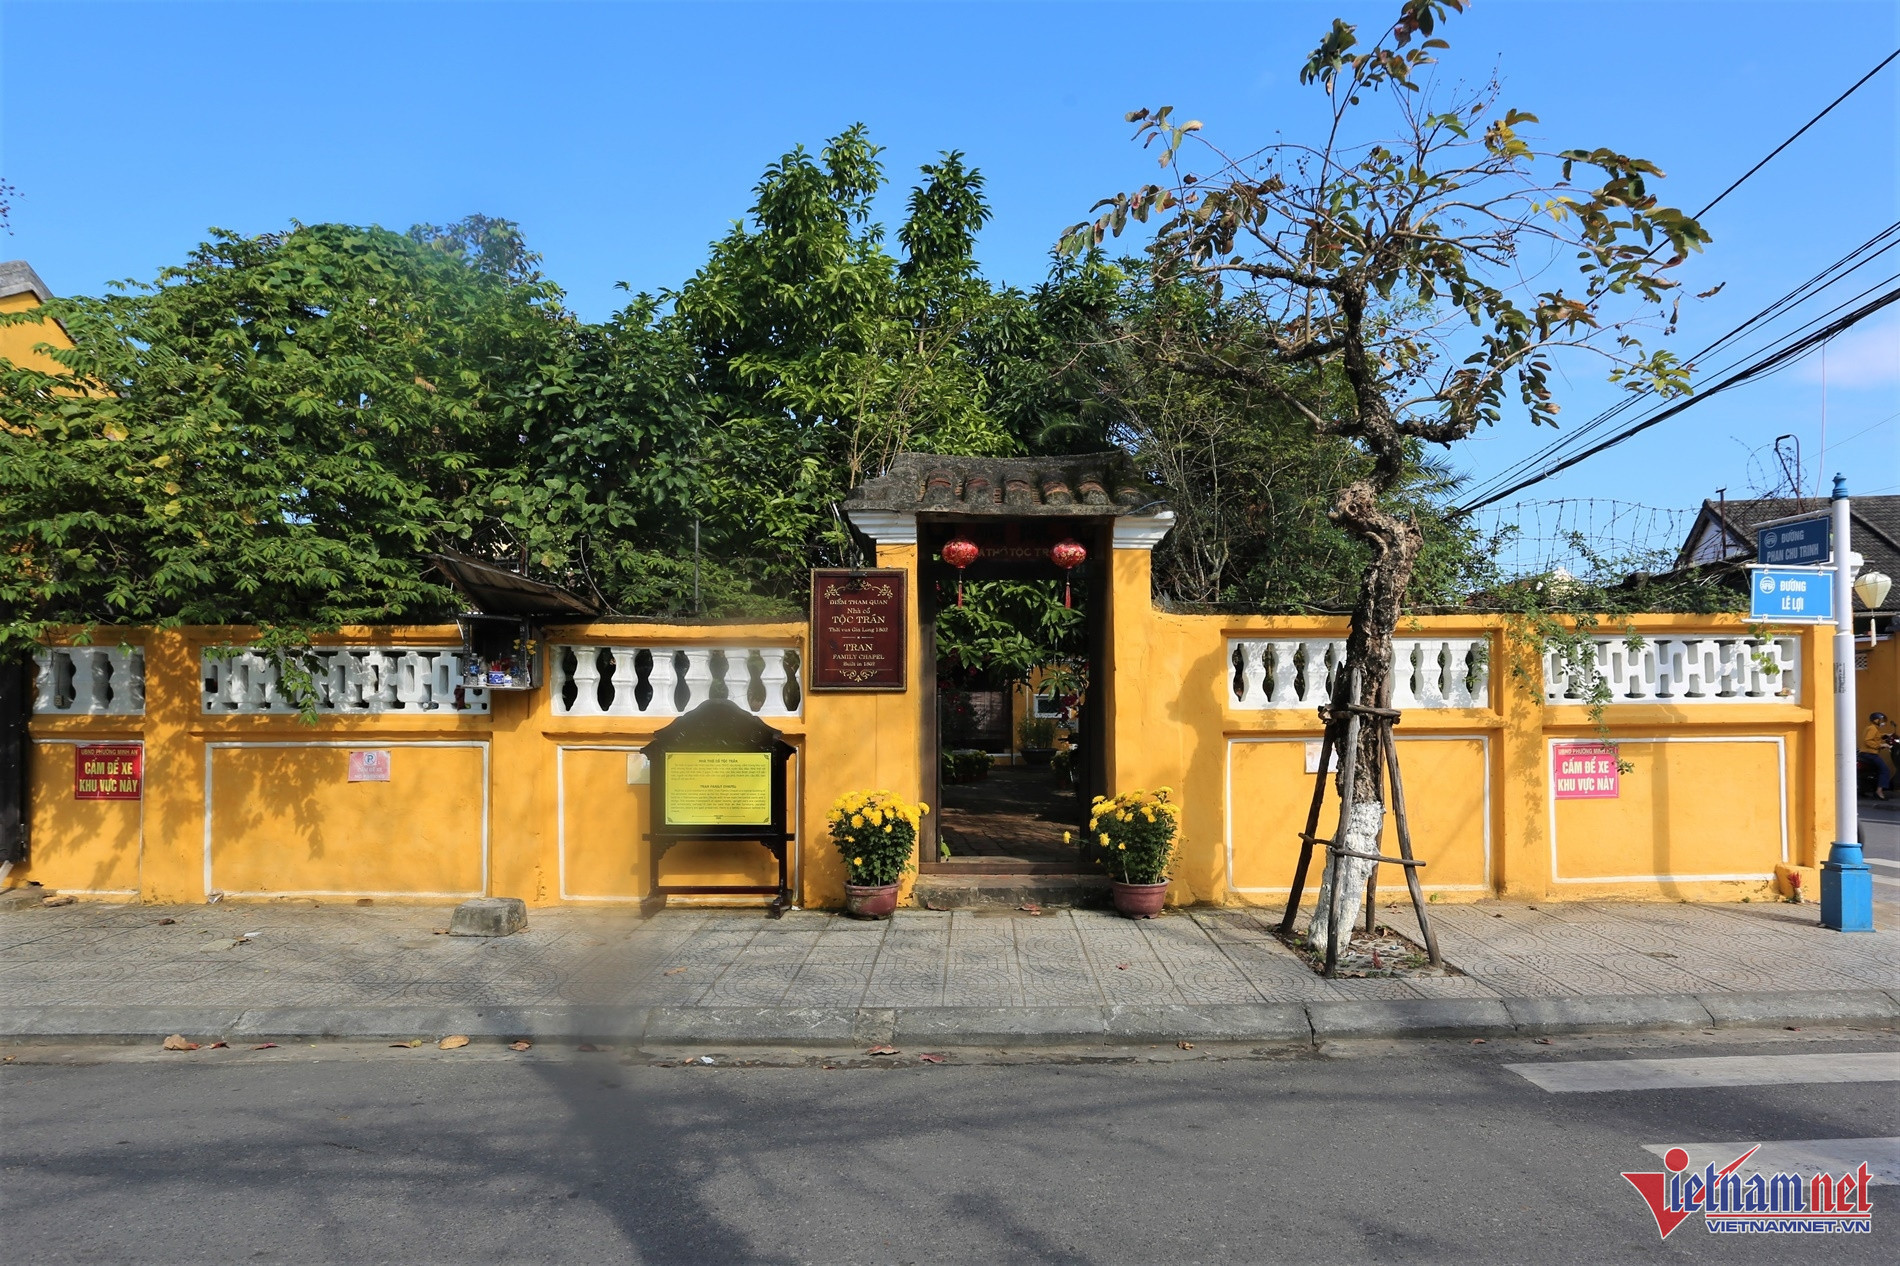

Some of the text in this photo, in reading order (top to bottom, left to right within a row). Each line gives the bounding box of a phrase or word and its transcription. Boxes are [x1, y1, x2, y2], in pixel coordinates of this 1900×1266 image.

[1781, 530, 1804, 543] ĐƯỜNG
[1766, 543, 1819, 562] PHAN CHU TRINH
[1780, 578, 1806, 592] ĐƯỜNG
[1782, 595, 1804, 613] LÊ LỢI
[832, 614, 854, 626] TỘC
[844, 644, 873, 652] TRAN
[85, 757, 133, 775] CẤM ĐỂ XE
[1562, 756, 1609, 774] CẤM ĐỂ XE
[80, 777, 138, 795] KHU VỰC NÀY
[1558, 775, 1615, 794] KHU VỰC NÀY
